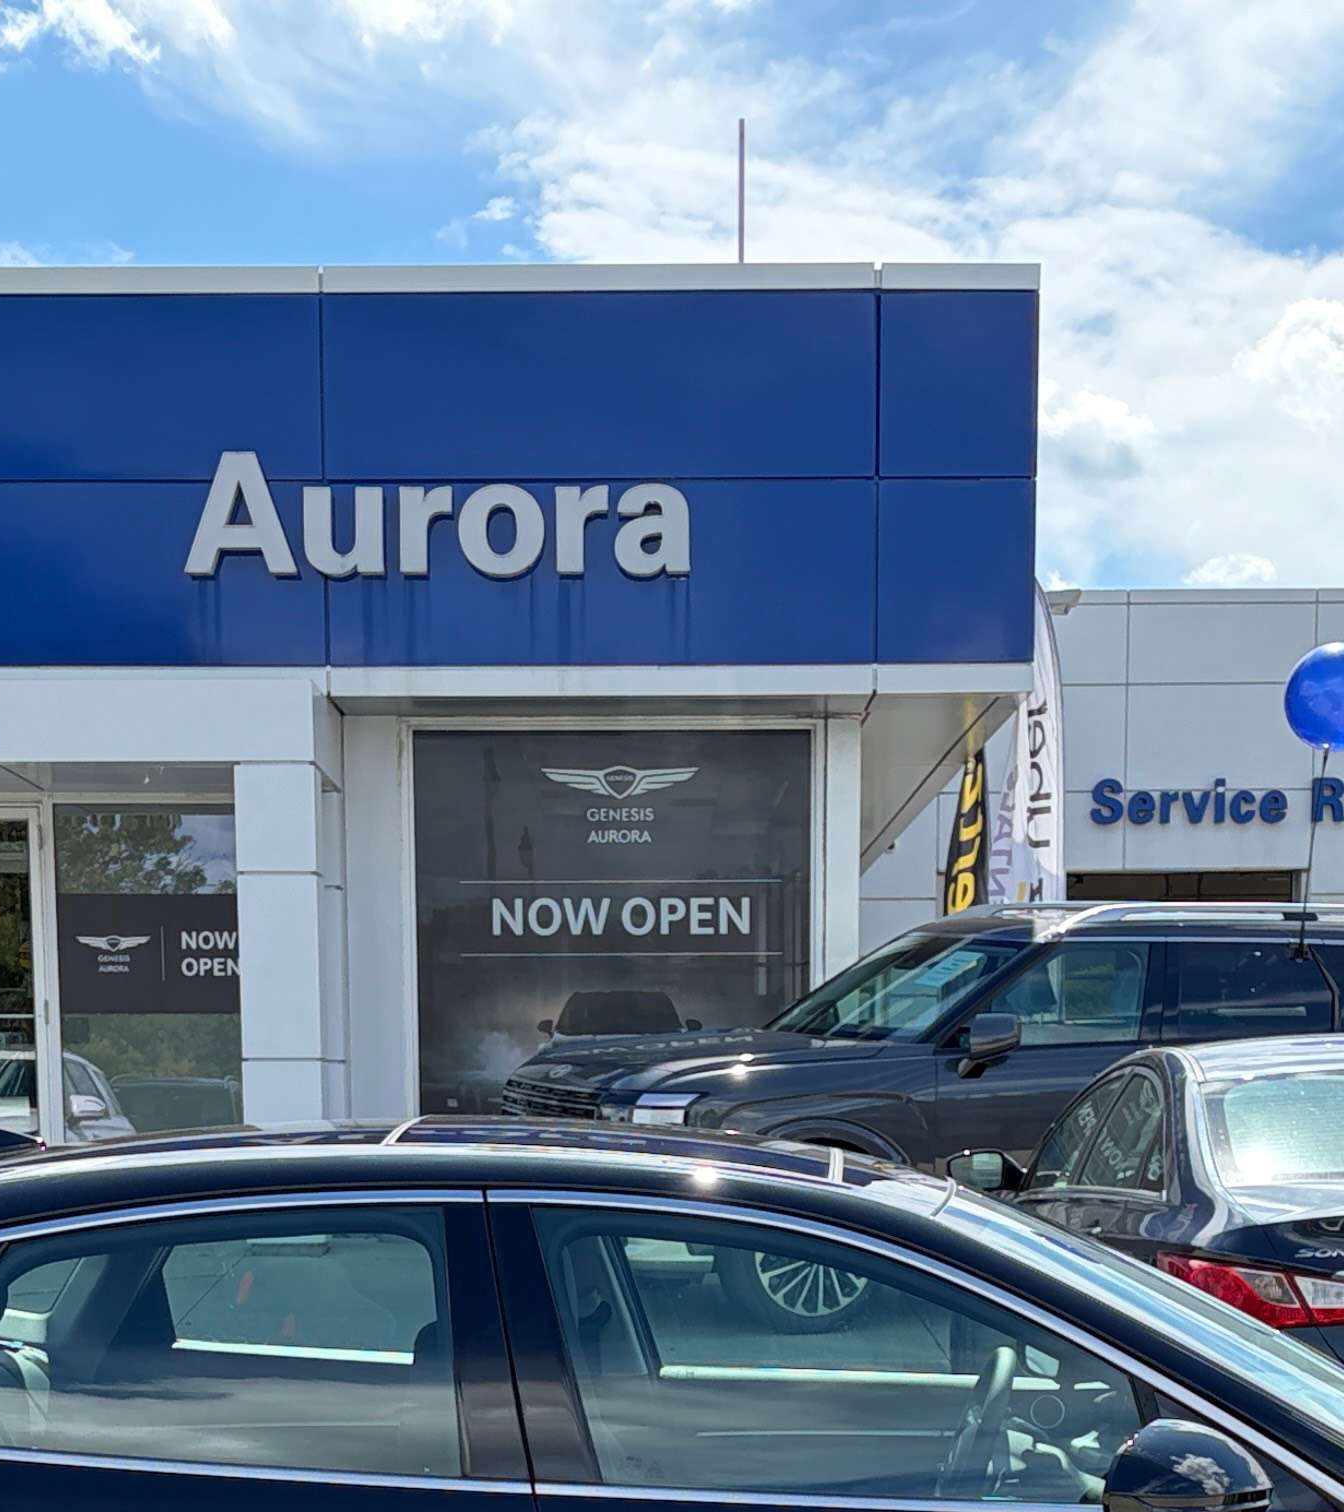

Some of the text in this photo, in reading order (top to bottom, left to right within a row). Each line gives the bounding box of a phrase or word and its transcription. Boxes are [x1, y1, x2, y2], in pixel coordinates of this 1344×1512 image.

[183, 450, 692, 580] Aurora
[1090, 777, 1289, 826] Service
[586, 807, 655, 822] GENESIS
[587, 829, 652, 844] AURORA
[492, 896, 751, 936] NOW OPEN
[181, 930, 237, 950] NOW
[97, 954, 131, 963] GENESIS
[98, 965, 130, 973] AURORA
